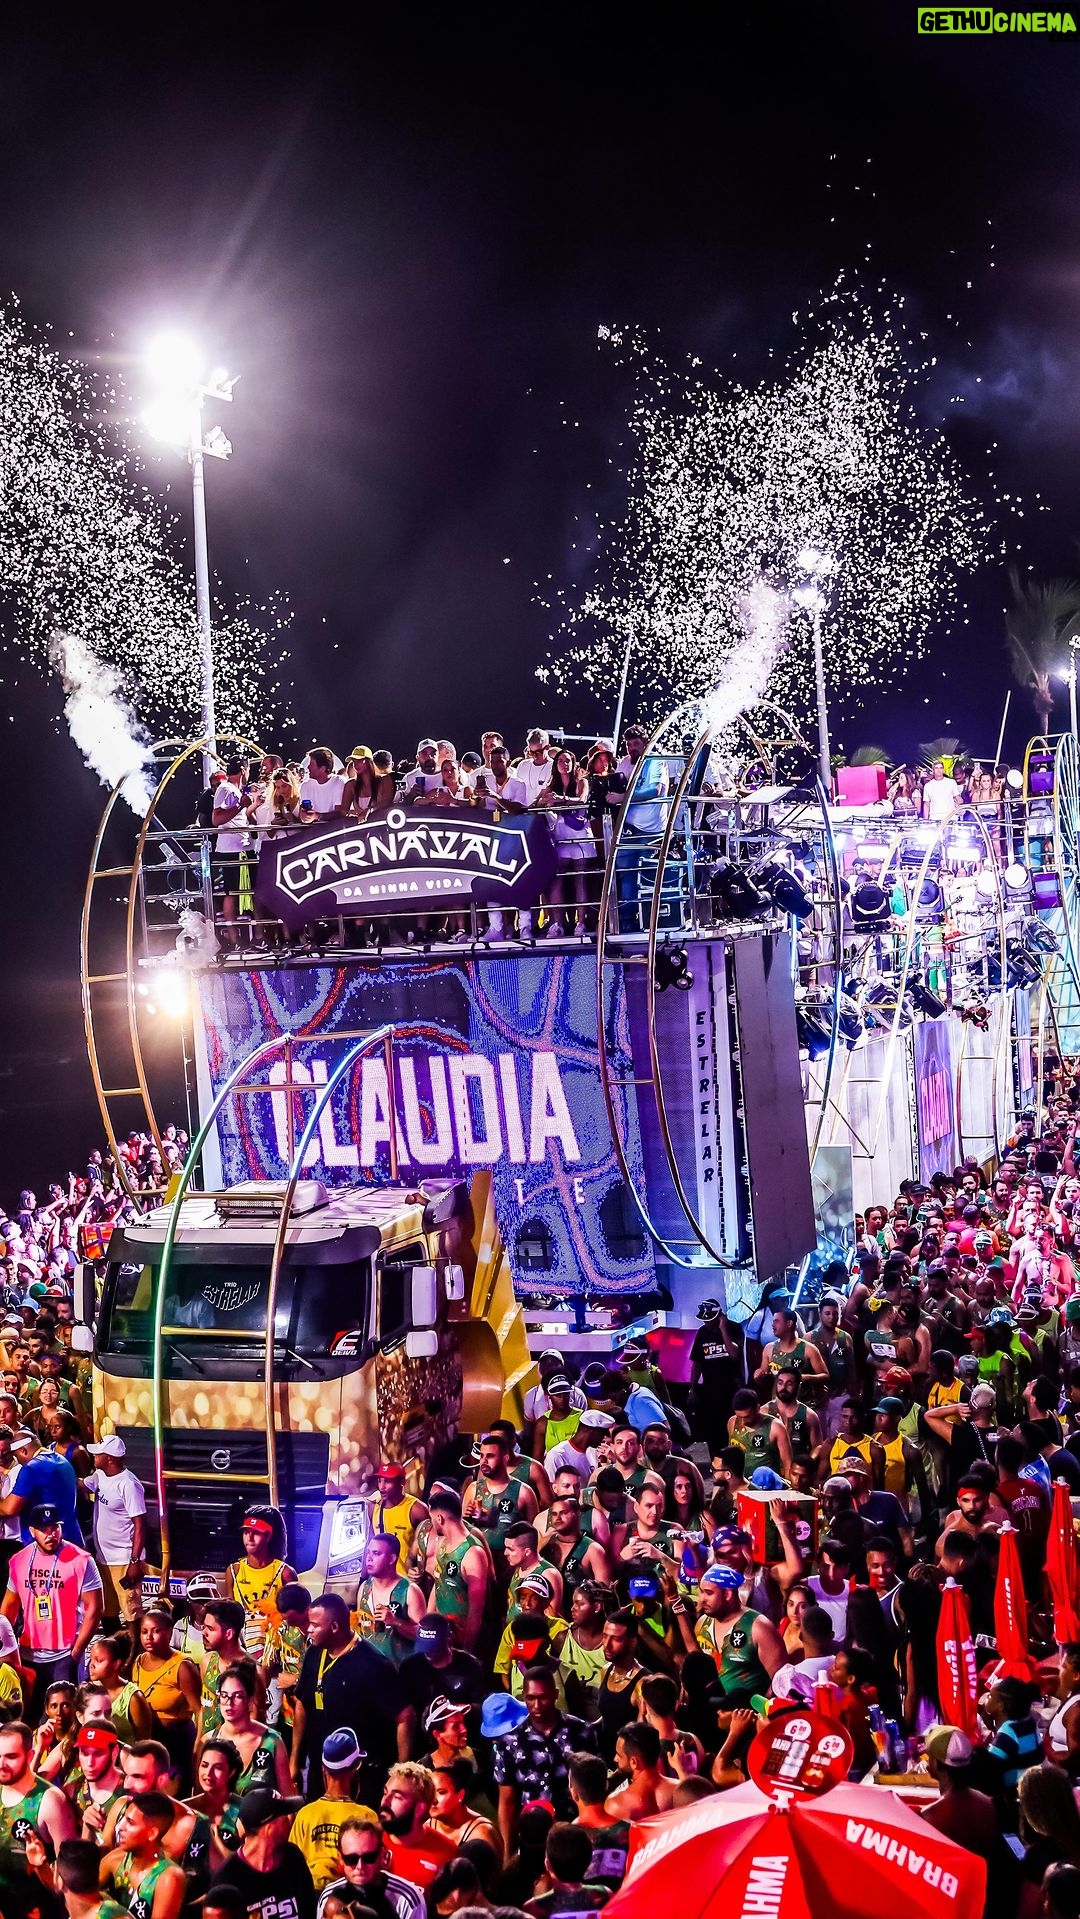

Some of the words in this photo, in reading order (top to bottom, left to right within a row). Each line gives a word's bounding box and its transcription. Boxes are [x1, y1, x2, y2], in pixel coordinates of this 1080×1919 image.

[282, 831, 518, 890] CARNAVAL
[343, 887, 363, 897] DA
[369, 881, 419, 895] MINHA
[425, 878, 463, 890] VIDA
[268, 1052, 581, 1168] CLAUDIA
[695, 1011, 715, 1183] ESTRELAR
[846, 1819, 959, 1899] BRAHMA
